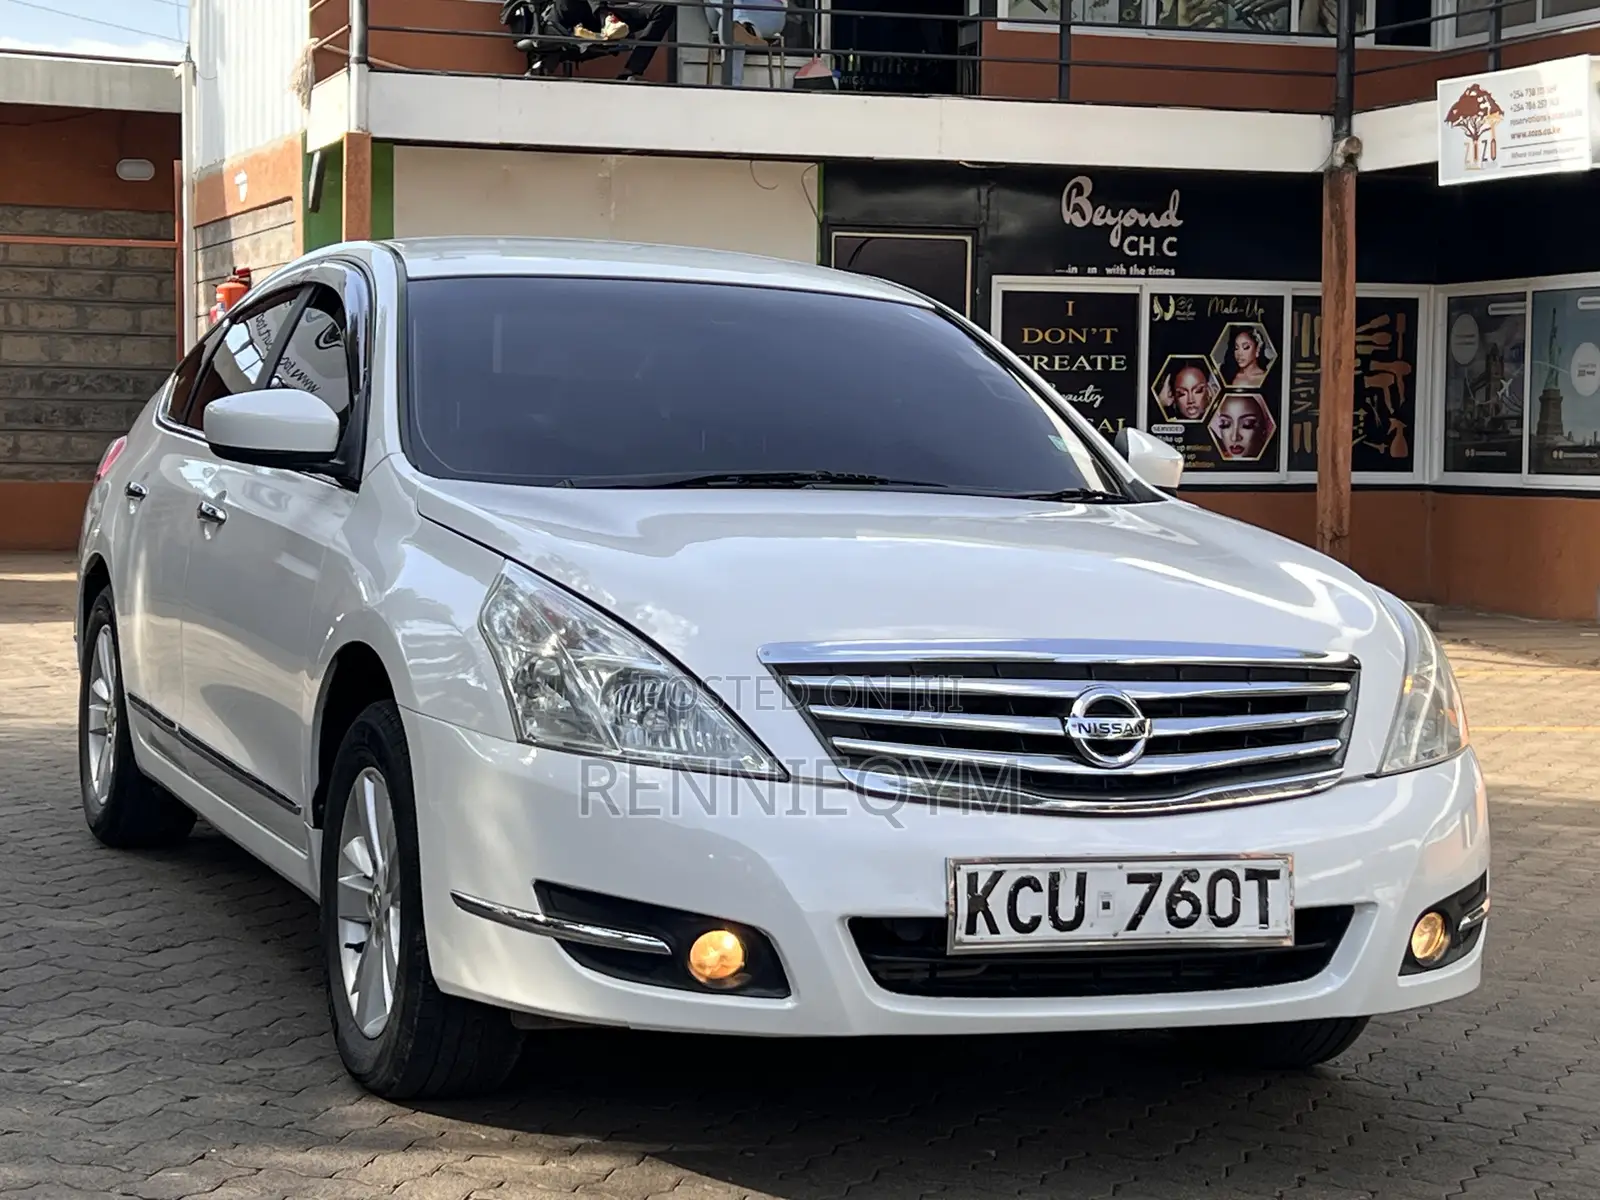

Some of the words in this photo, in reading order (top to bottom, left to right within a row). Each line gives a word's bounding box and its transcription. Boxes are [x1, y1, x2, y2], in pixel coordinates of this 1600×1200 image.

[1061, 175, 1183, 247] Beyond
[1105, 263, 1127, 275] with
[1129, 264, 1146, 276] the
[1148, 265, 1176, 276] times
[1066, 300, 1075, 317] I
[1022, 326, 1119, 344] DON'T
[1077, 722, 1146, 735] NISSAN
[964, 869, 1088, 936] KCU
[1123, 867, 1282, 932] 760T
